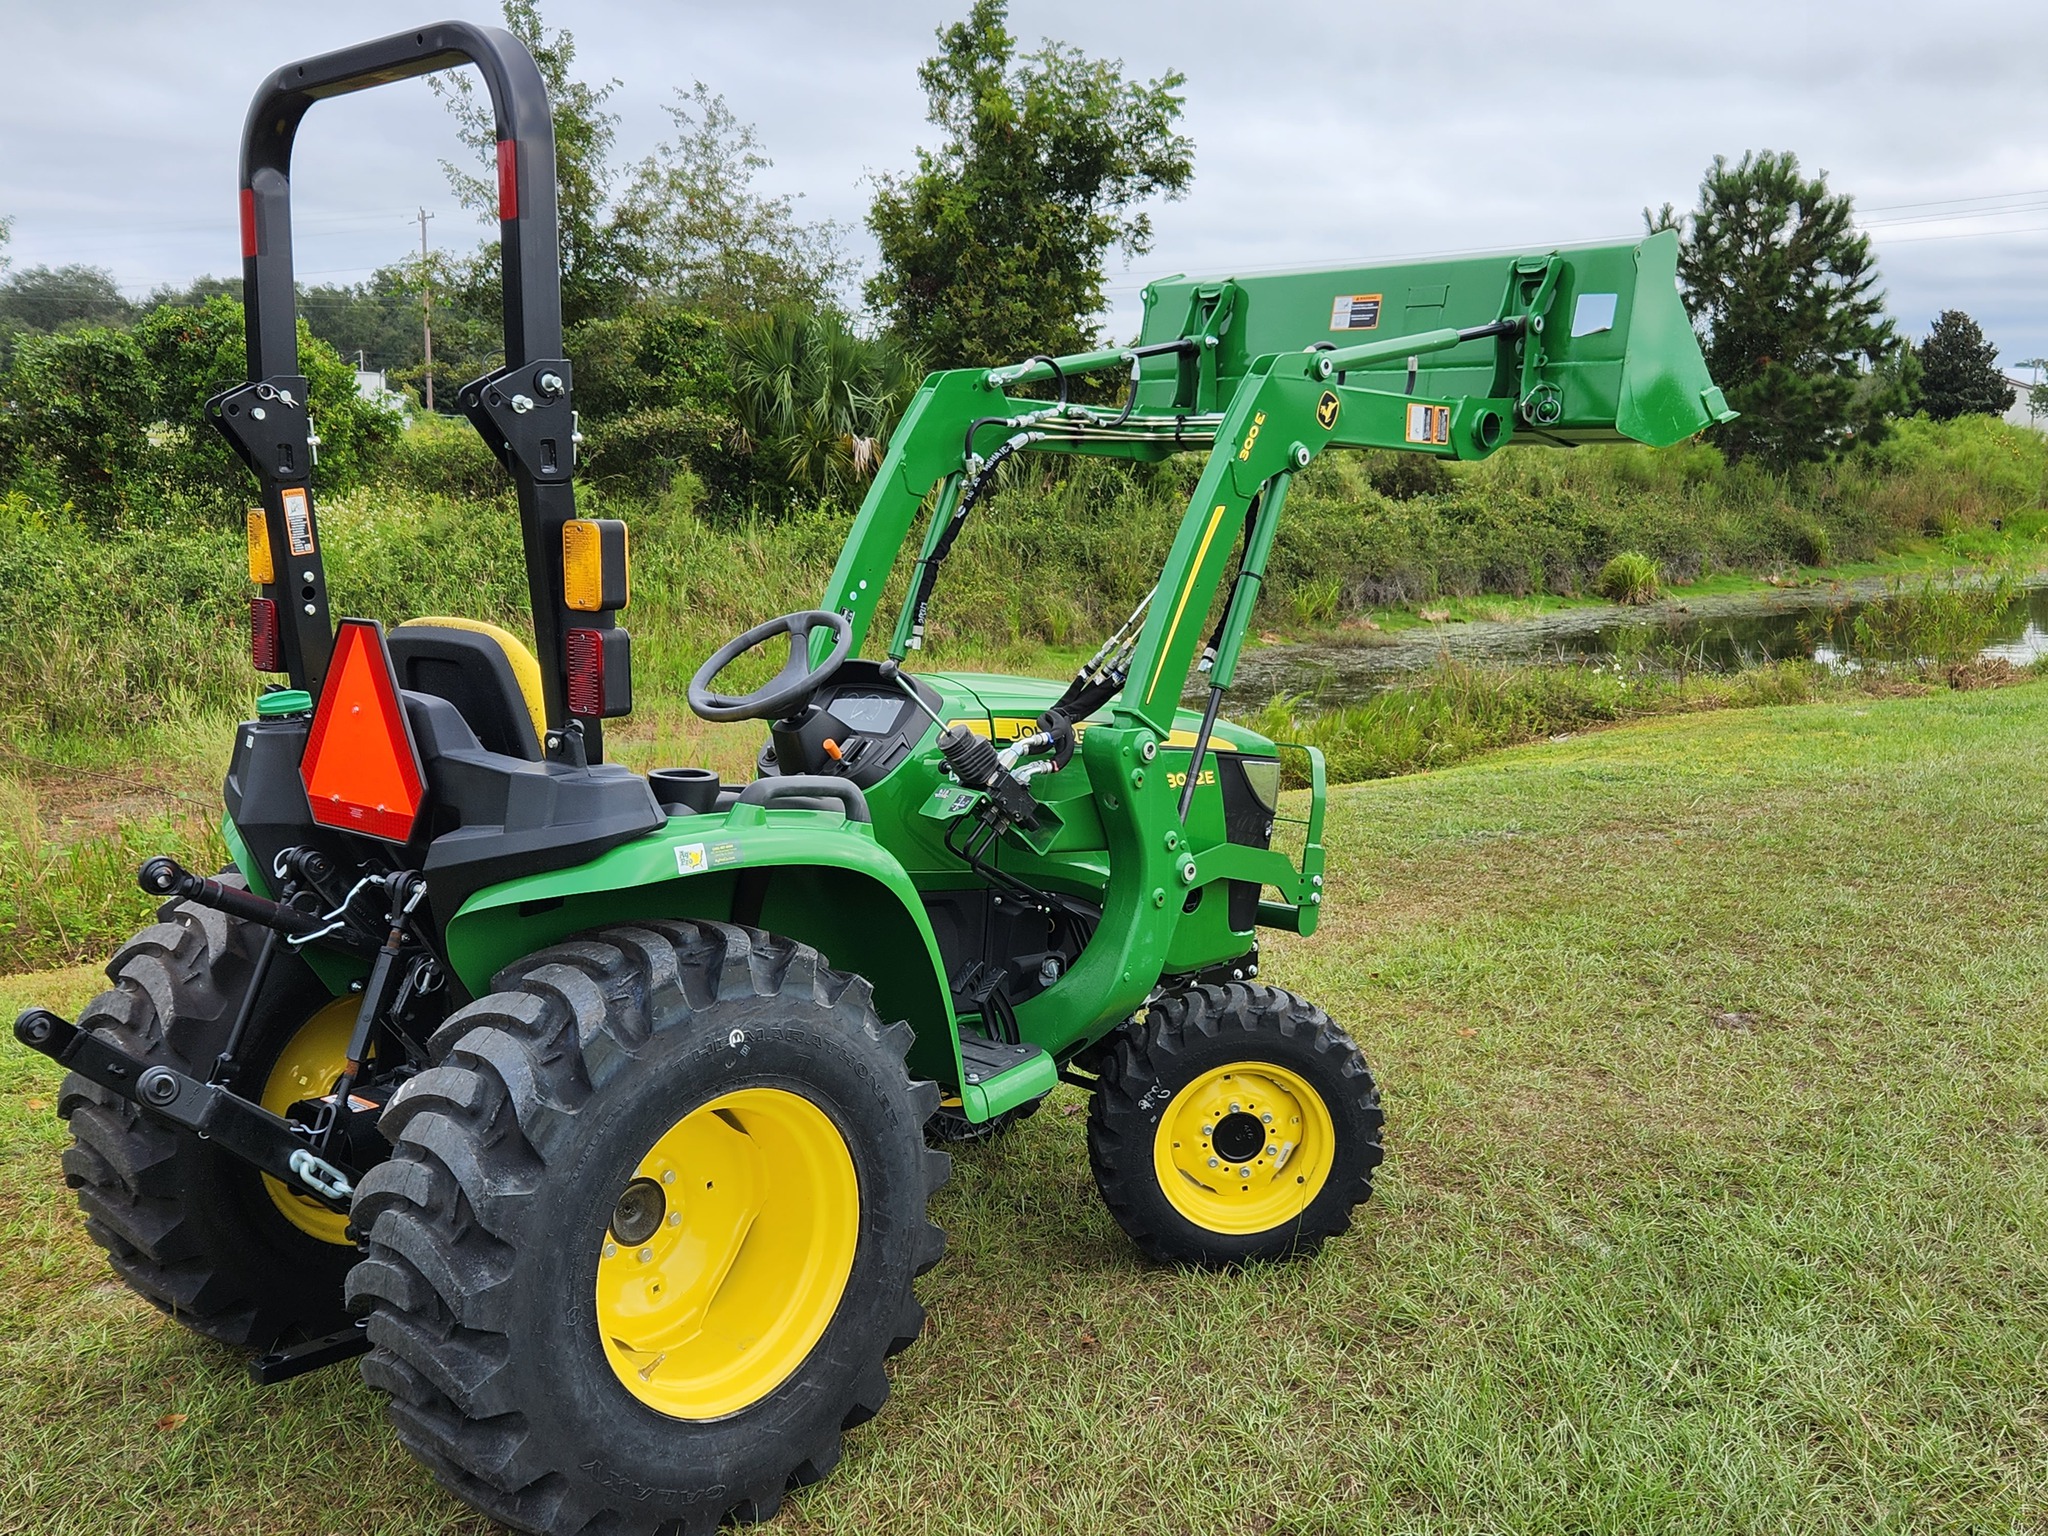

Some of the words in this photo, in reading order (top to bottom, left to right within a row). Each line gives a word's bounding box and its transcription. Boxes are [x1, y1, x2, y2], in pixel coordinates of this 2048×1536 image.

[1238, 410, 1267, 462] 300E
[1166, 770, 1215, 789] 302E
[743, 1027, 899, 1131] MARATHONER
[579, 1459, 727, 1505] GALAXY
